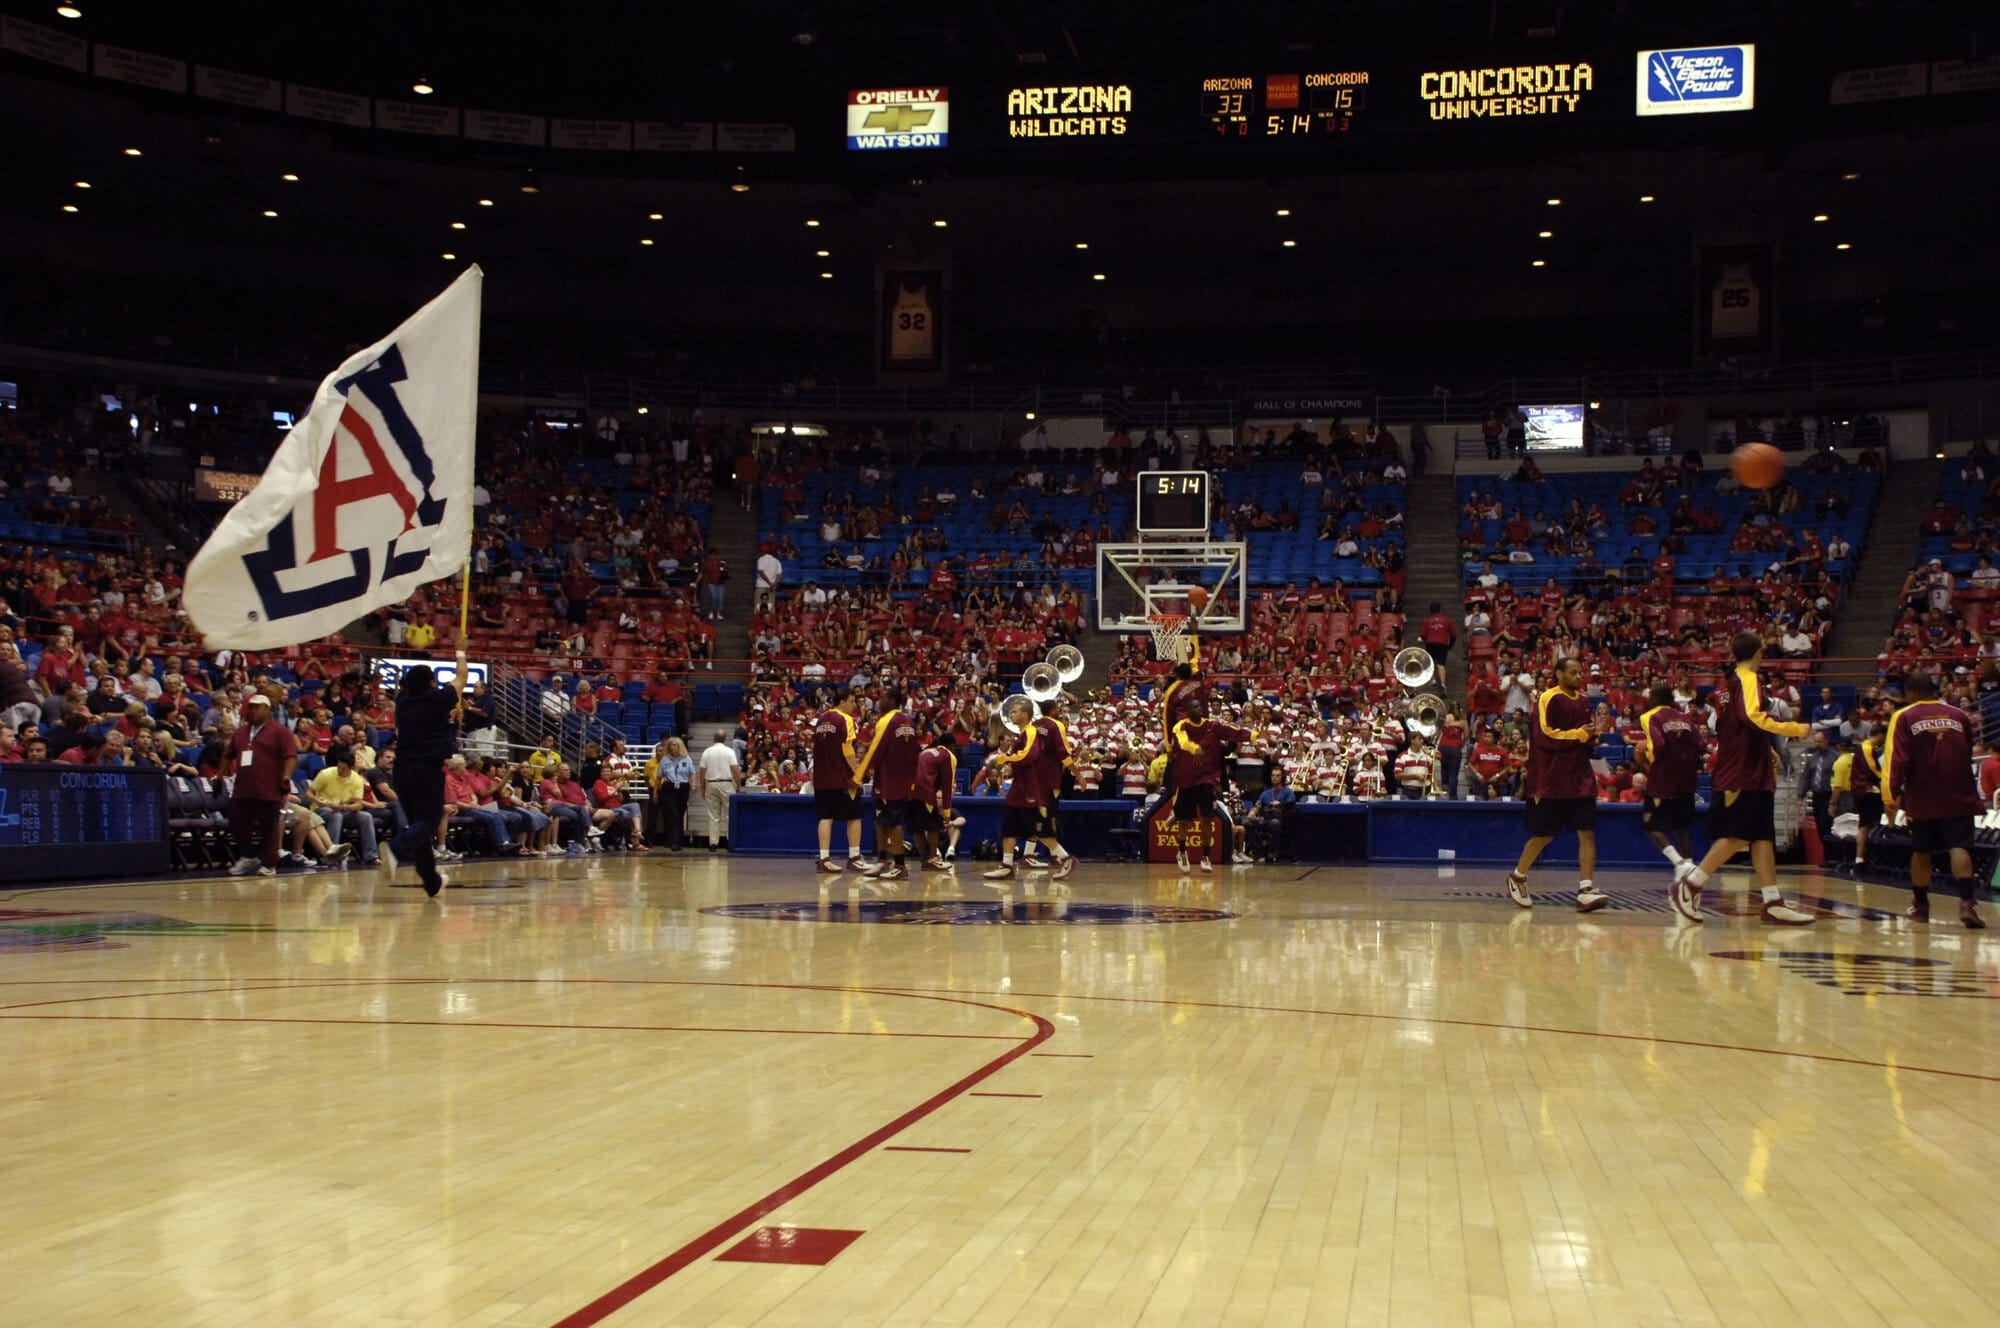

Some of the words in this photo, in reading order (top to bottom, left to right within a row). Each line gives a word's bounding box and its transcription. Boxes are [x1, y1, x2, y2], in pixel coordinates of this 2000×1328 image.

[1670, 56, 1724, 70] Tucson
[1305, 72, 1369, 87] CONCORDIA
[1420, 62, 1593, 100] CONCORDIA
[1676, 66, 1735, 81] Electric
[1203, 77, 1253, 92] ARIZONA
[1681, 80, 1735, 94] Power
[856, 89, 939, 105] O'RIELLY
[1008, 86, 1132, 116] ARIZONA
[1217, 94, 1243, 114] 33
[1335, 89, 1353, 109] 15
[1430, 94, 1580, 120] UNIVERSITY
[1010, 117, 1127, 138] WILDCATS
[1267, 114, 1310, 135] 5:14
[857, 135, 940, 149] WATSON
[1722, 288, 1749, 308] 25
[900, 313, 925, 330] 32
[1254, 400, 1280, 409] HALL
[1284, 400, 1297, 409] OF
[1300, 399, 1362, 409] CHAMPIONS
[1158, 477, 1200, 495] 5:14
[528, 586, 537, 595] 19
[573, 659, 583, 669] 19
[1911, 718, 1963, 735] STINGERS
[60, 772, 128, 788] CONCORDIA
[21, 803, 39, 815] PTS
[21, 817, 40, 829] REB
[22, 831, 39, 843] FLS
[1156, 835, 1216, 848] FAG
